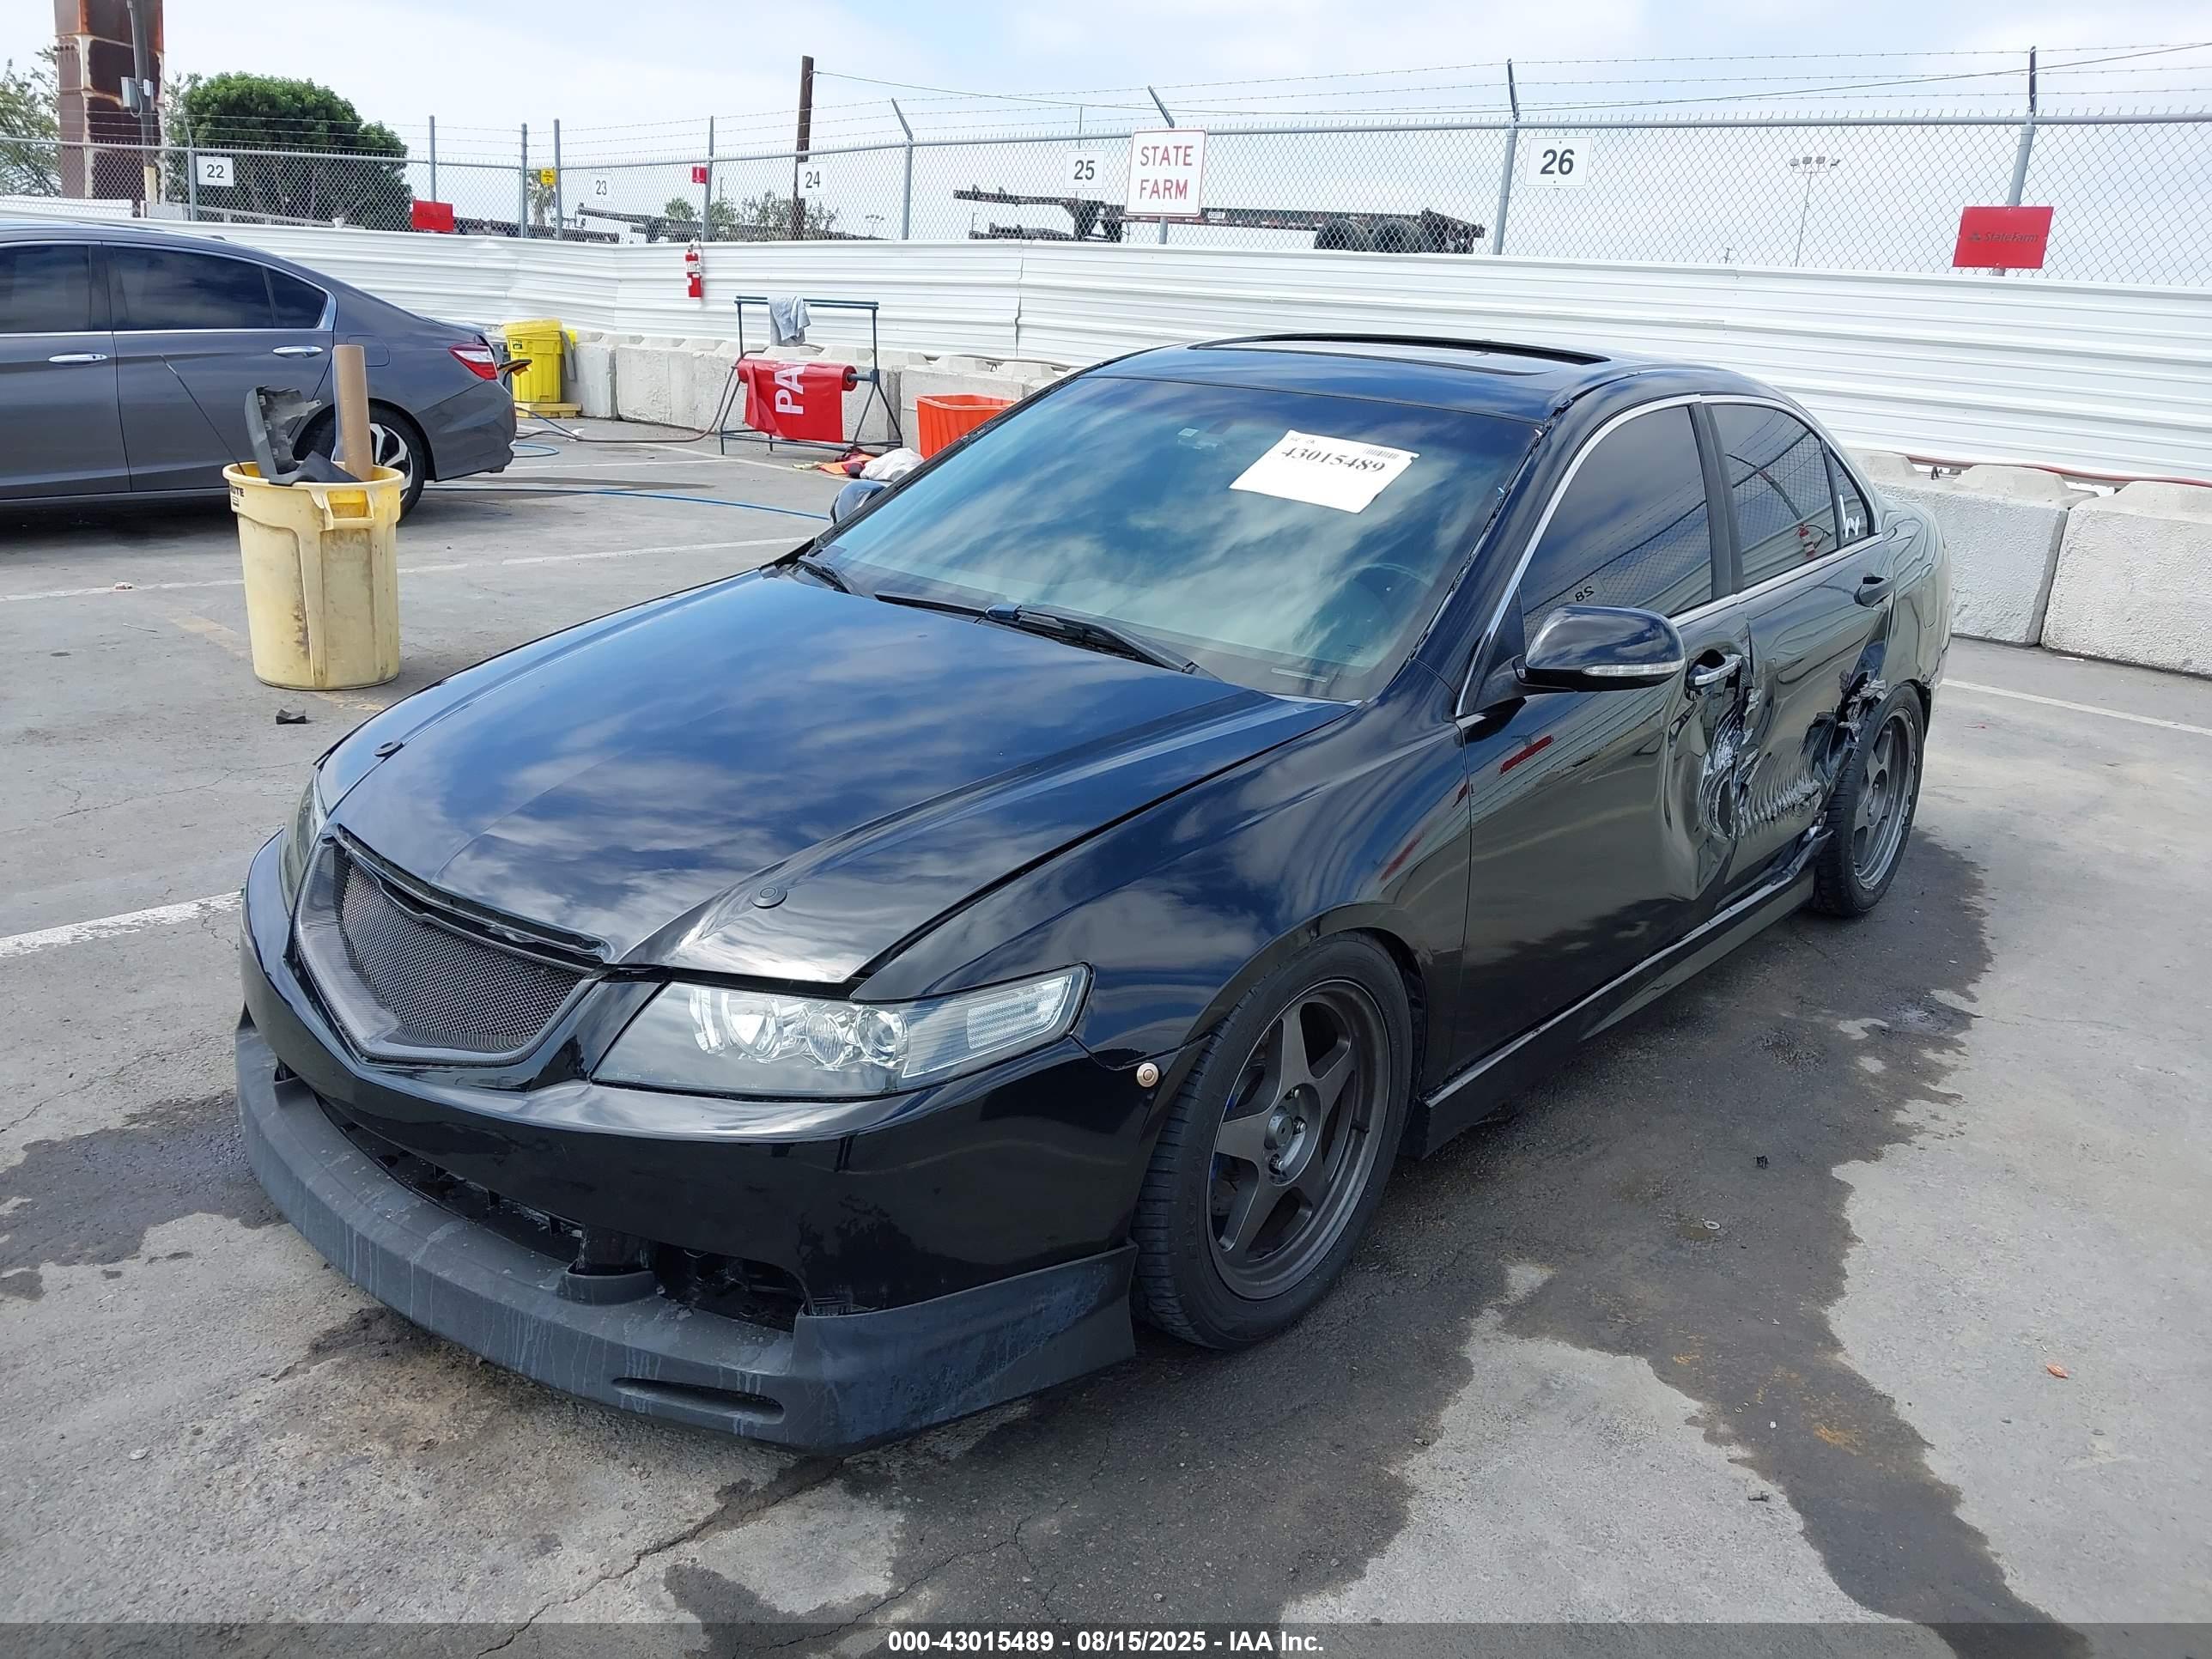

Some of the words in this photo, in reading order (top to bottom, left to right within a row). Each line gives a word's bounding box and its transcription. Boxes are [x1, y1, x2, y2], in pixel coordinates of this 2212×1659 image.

[1139, 145, 1194, 167] STATE
[1540, 149, 1575, 175] 26
[206, 164, 225, 179] 22
[805, 171, 821, 189] 24
[1073, 160, 1096, 180] 25
[595, 179, 607, 196] 23
[1139, 179, 1188, 200] FARM
[775, 359, 806, 414] PA
[1281, 447, 1386, 472] 43015489
[230, 483, 245, 498] UTE
